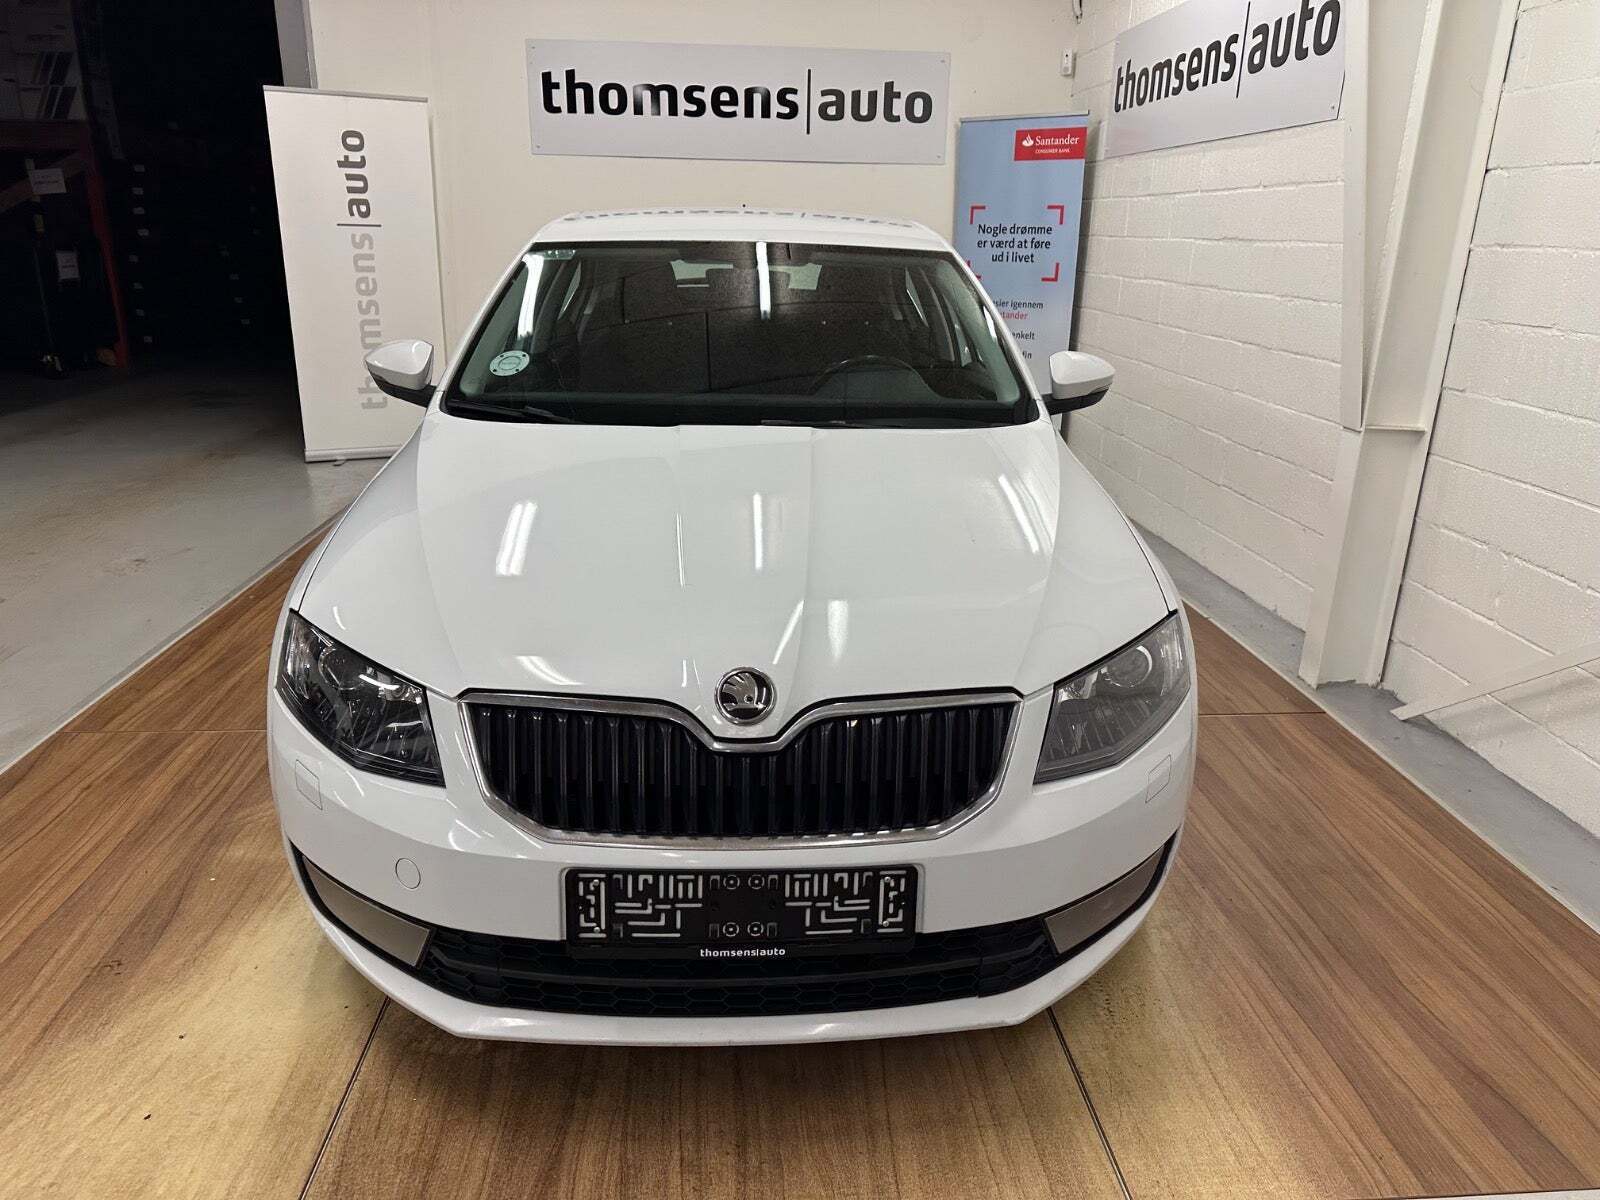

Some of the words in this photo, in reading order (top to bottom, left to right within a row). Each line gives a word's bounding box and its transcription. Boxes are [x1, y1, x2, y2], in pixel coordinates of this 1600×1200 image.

[1035, 133, 1080, 146] Santander
[977, 223, 1008, 238] Nogle
[1009, 223, 1053, 235] drømme
[976, 239, 988, 249] er
[989, 237, 1015, 249] værd
[1017, 238, 1028, 249] at
[1030, 237, 1051, 249] føre
[991, 251, 1004, 263] ud
[1006, 251, 1010, 263] i
[1011, 251, 1035, 263] livet
[1010, 299, 1044, 310] igennem
[1000, 311, 1028, 320] tander
